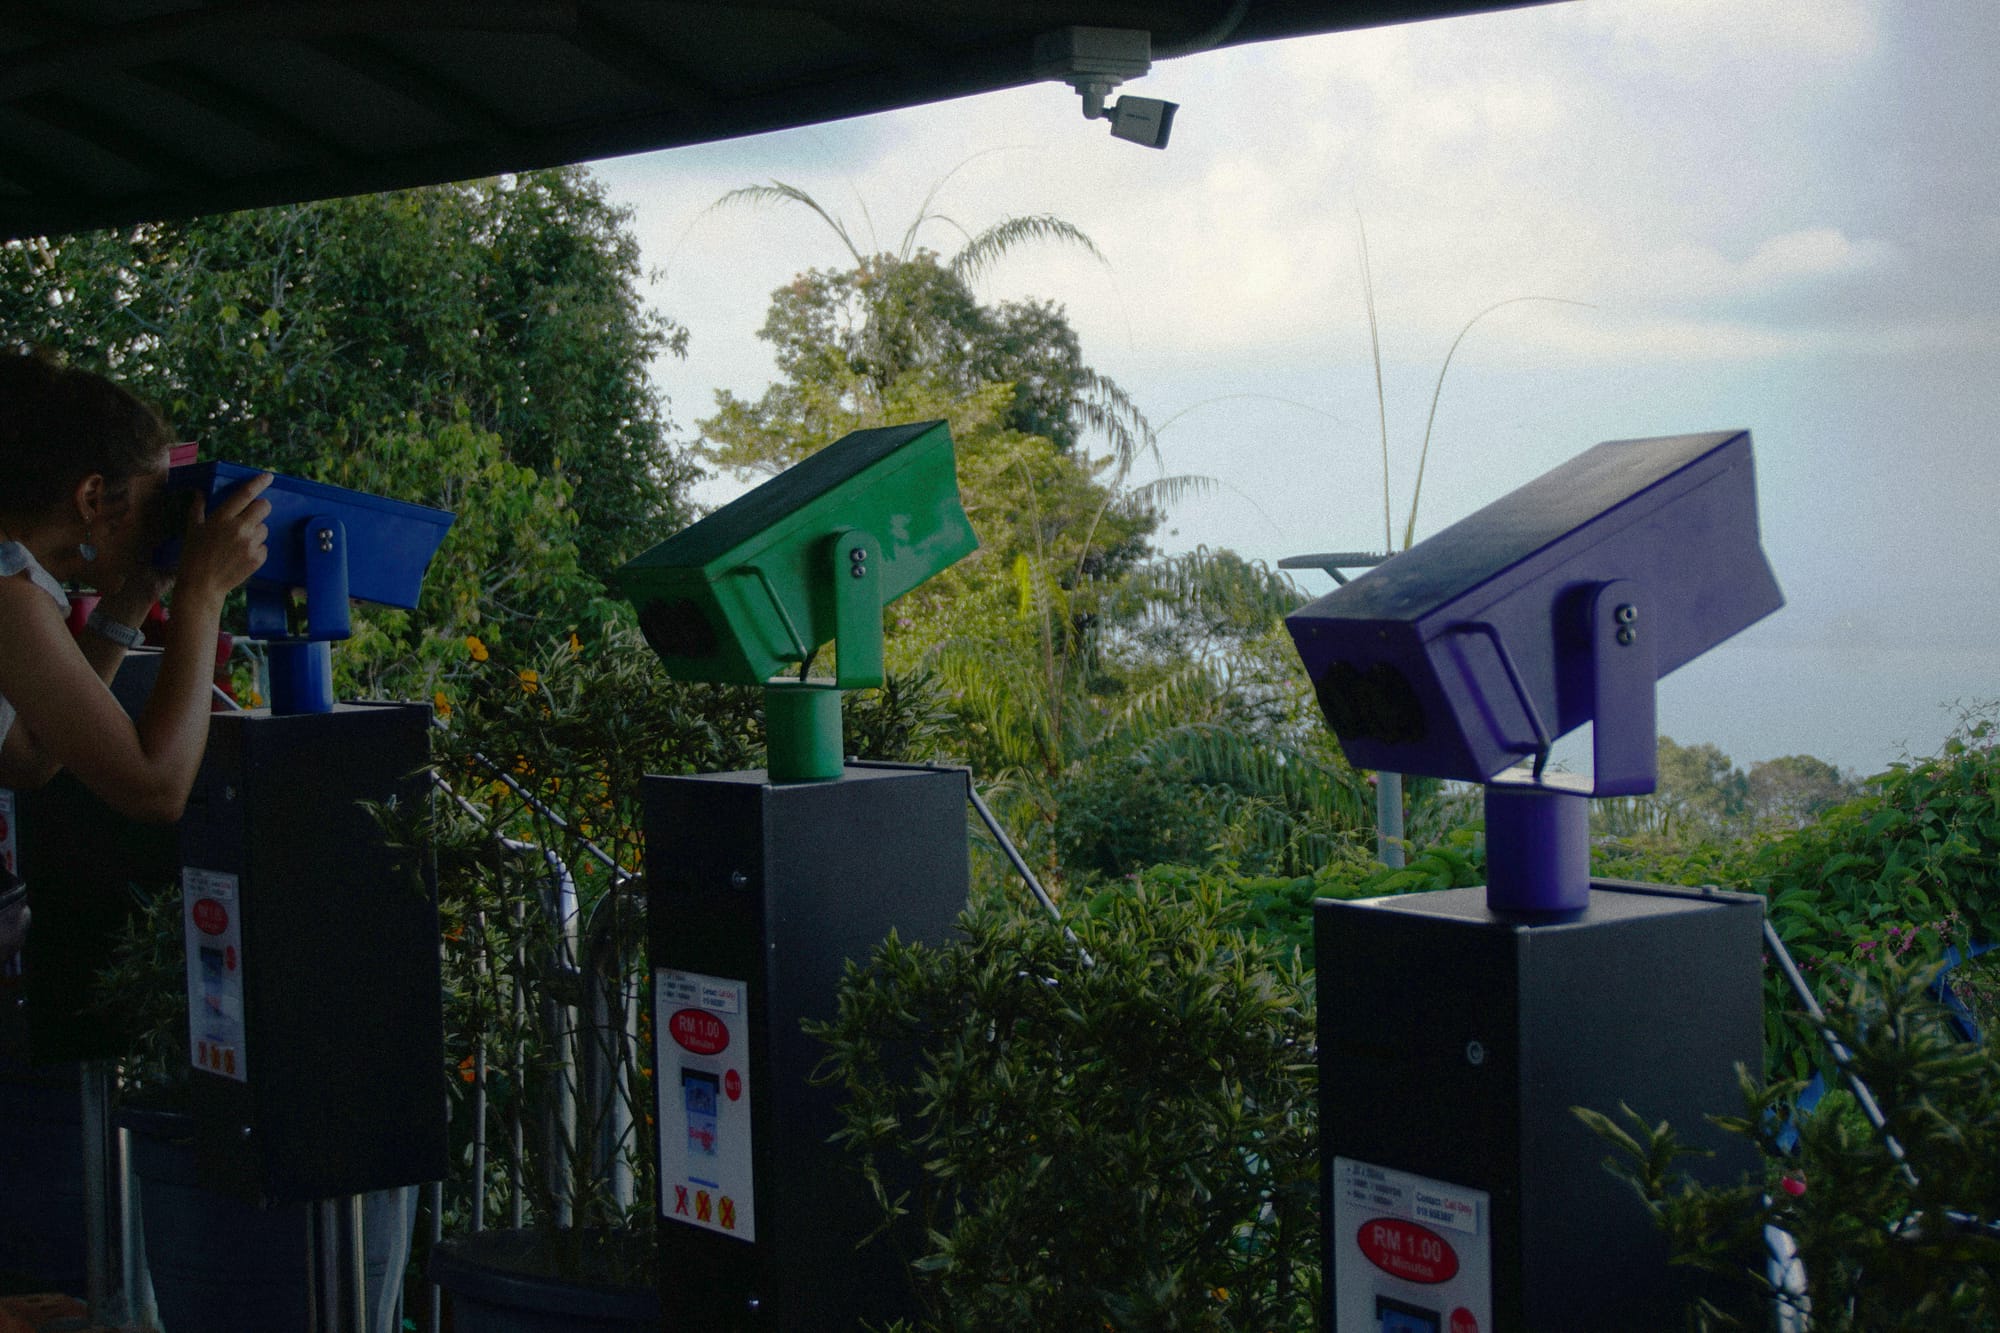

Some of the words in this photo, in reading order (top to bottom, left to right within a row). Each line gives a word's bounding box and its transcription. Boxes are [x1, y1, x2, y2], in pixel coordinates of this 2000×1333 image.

[680, 1016, 696, 1033] RM
[699, 1019, 719, 1038] 1.00
[1374, 1225, 1401, 1252] RM
[1407, 1235, 1441, 1263] 1.00
[1383, 1251, 1389, 1265] 2
[1391, 1256, 1433, 1277] Minutes
